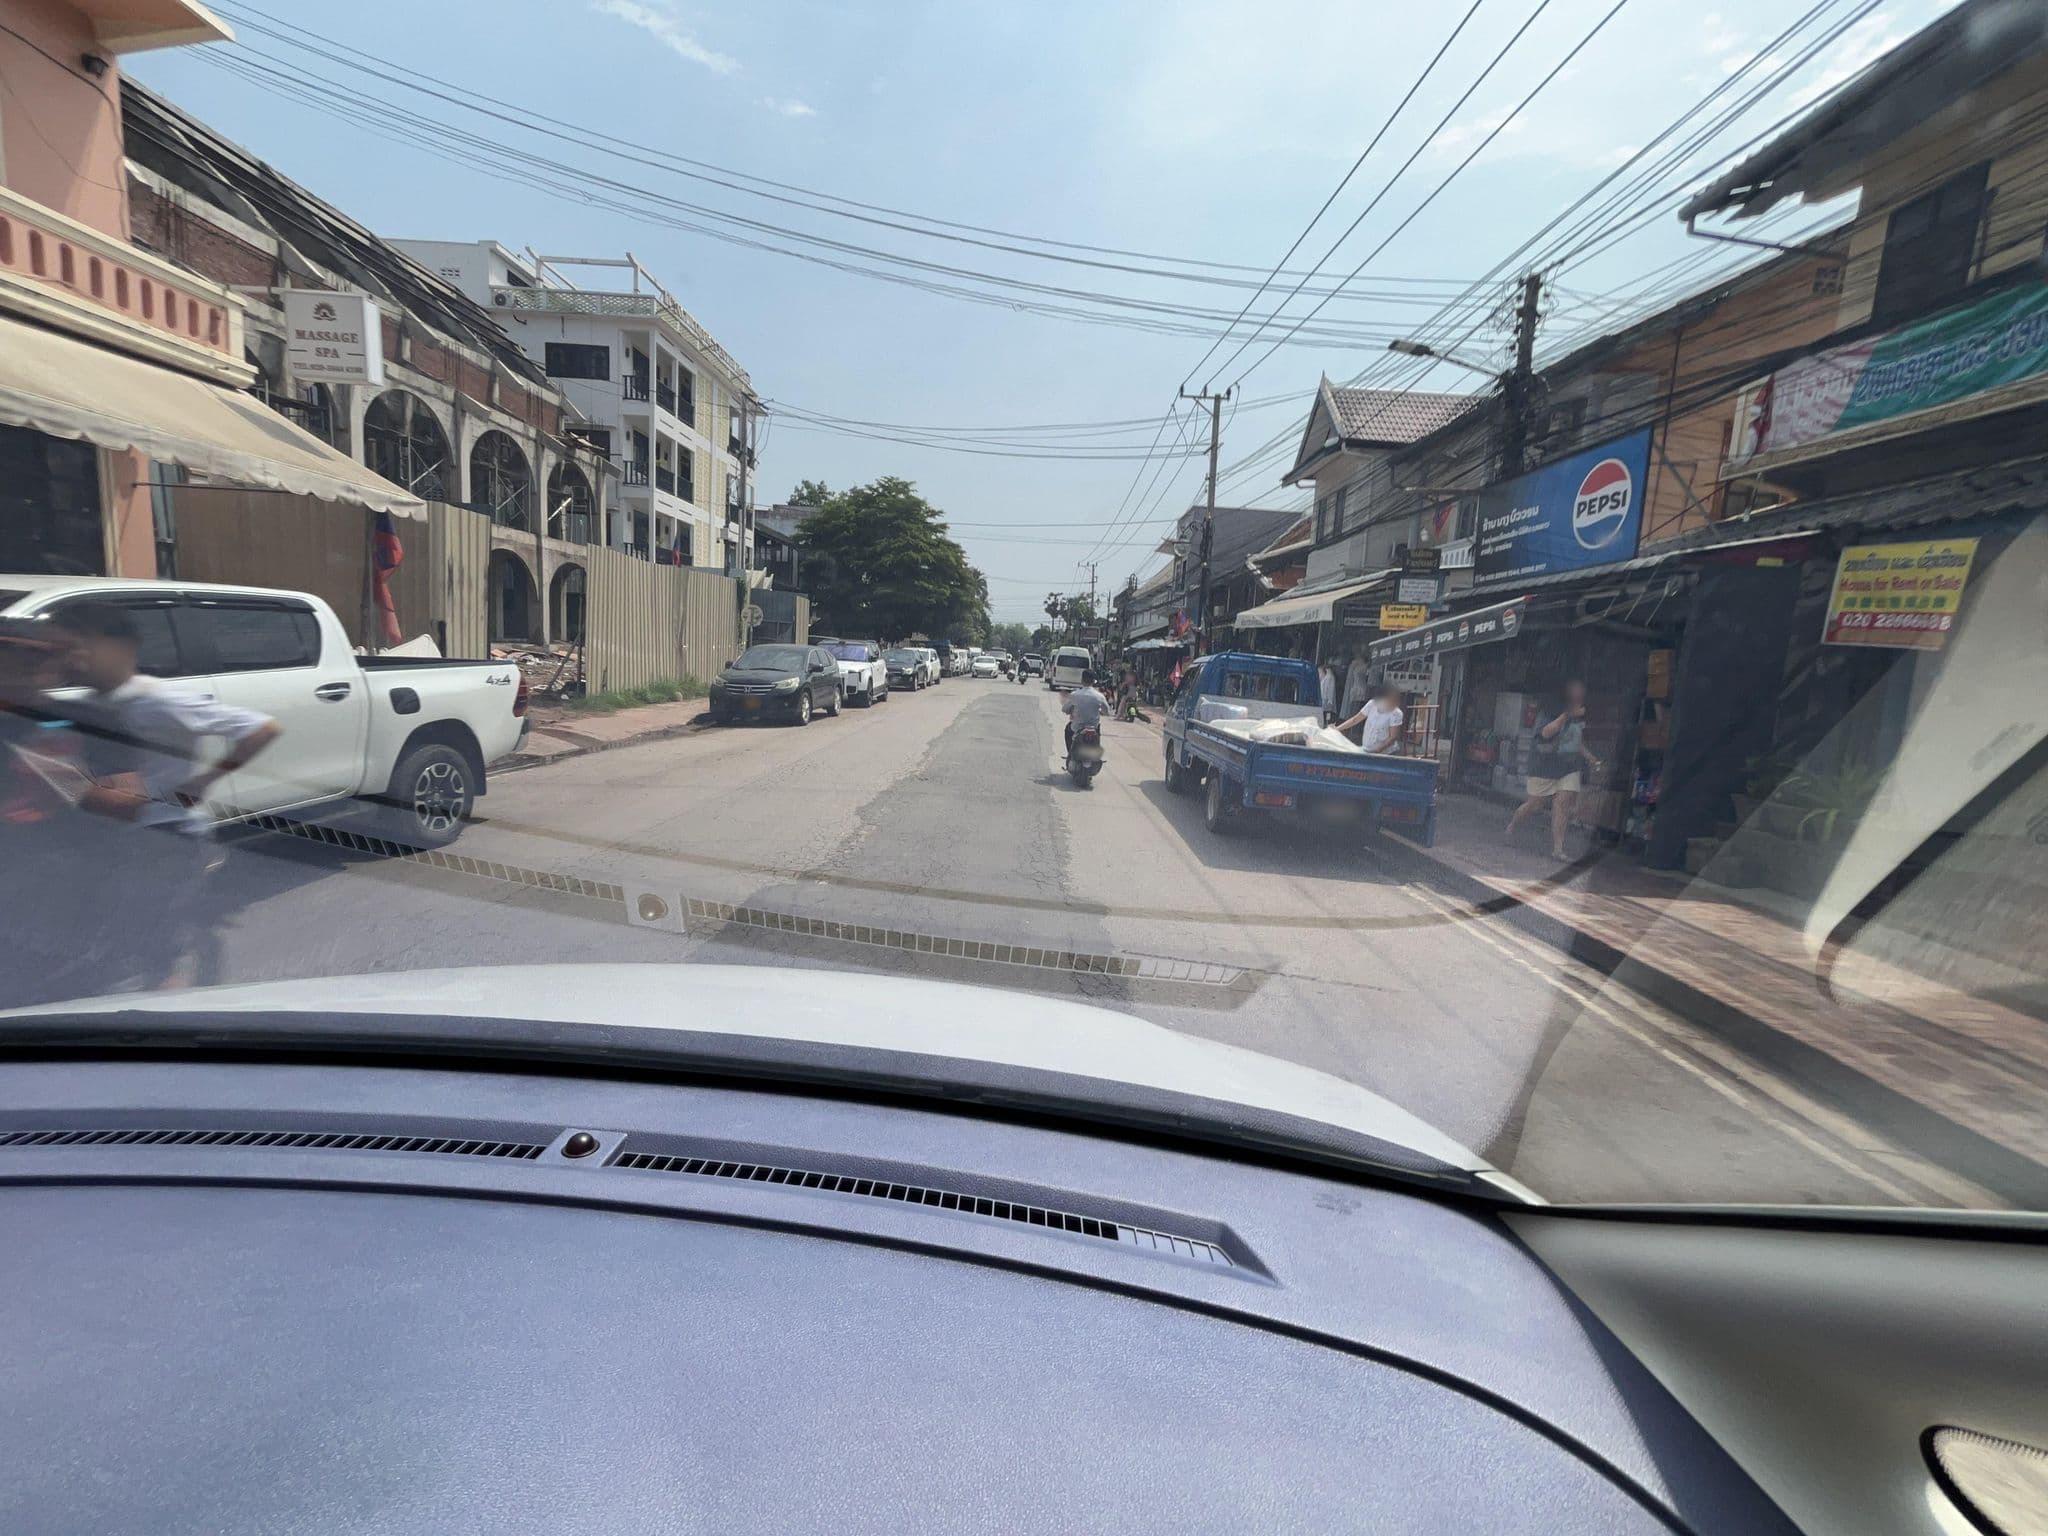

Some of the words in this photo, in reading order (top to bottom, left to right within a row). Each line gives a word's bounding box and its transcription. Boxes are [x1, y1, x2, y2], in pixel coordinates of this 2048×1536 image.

[295, 328, 359, 344] MASSAGE
[315, 346, 340, 359] SPA
[1576, 489, 1629, 519] PEPSI
[1842, 613, 1871, 628] 020
[1436, 631, 1454, 643] PEPSI
[1474, 620, 1496, 634] PEPSI
[486, 674, 511, 686] 4x4
